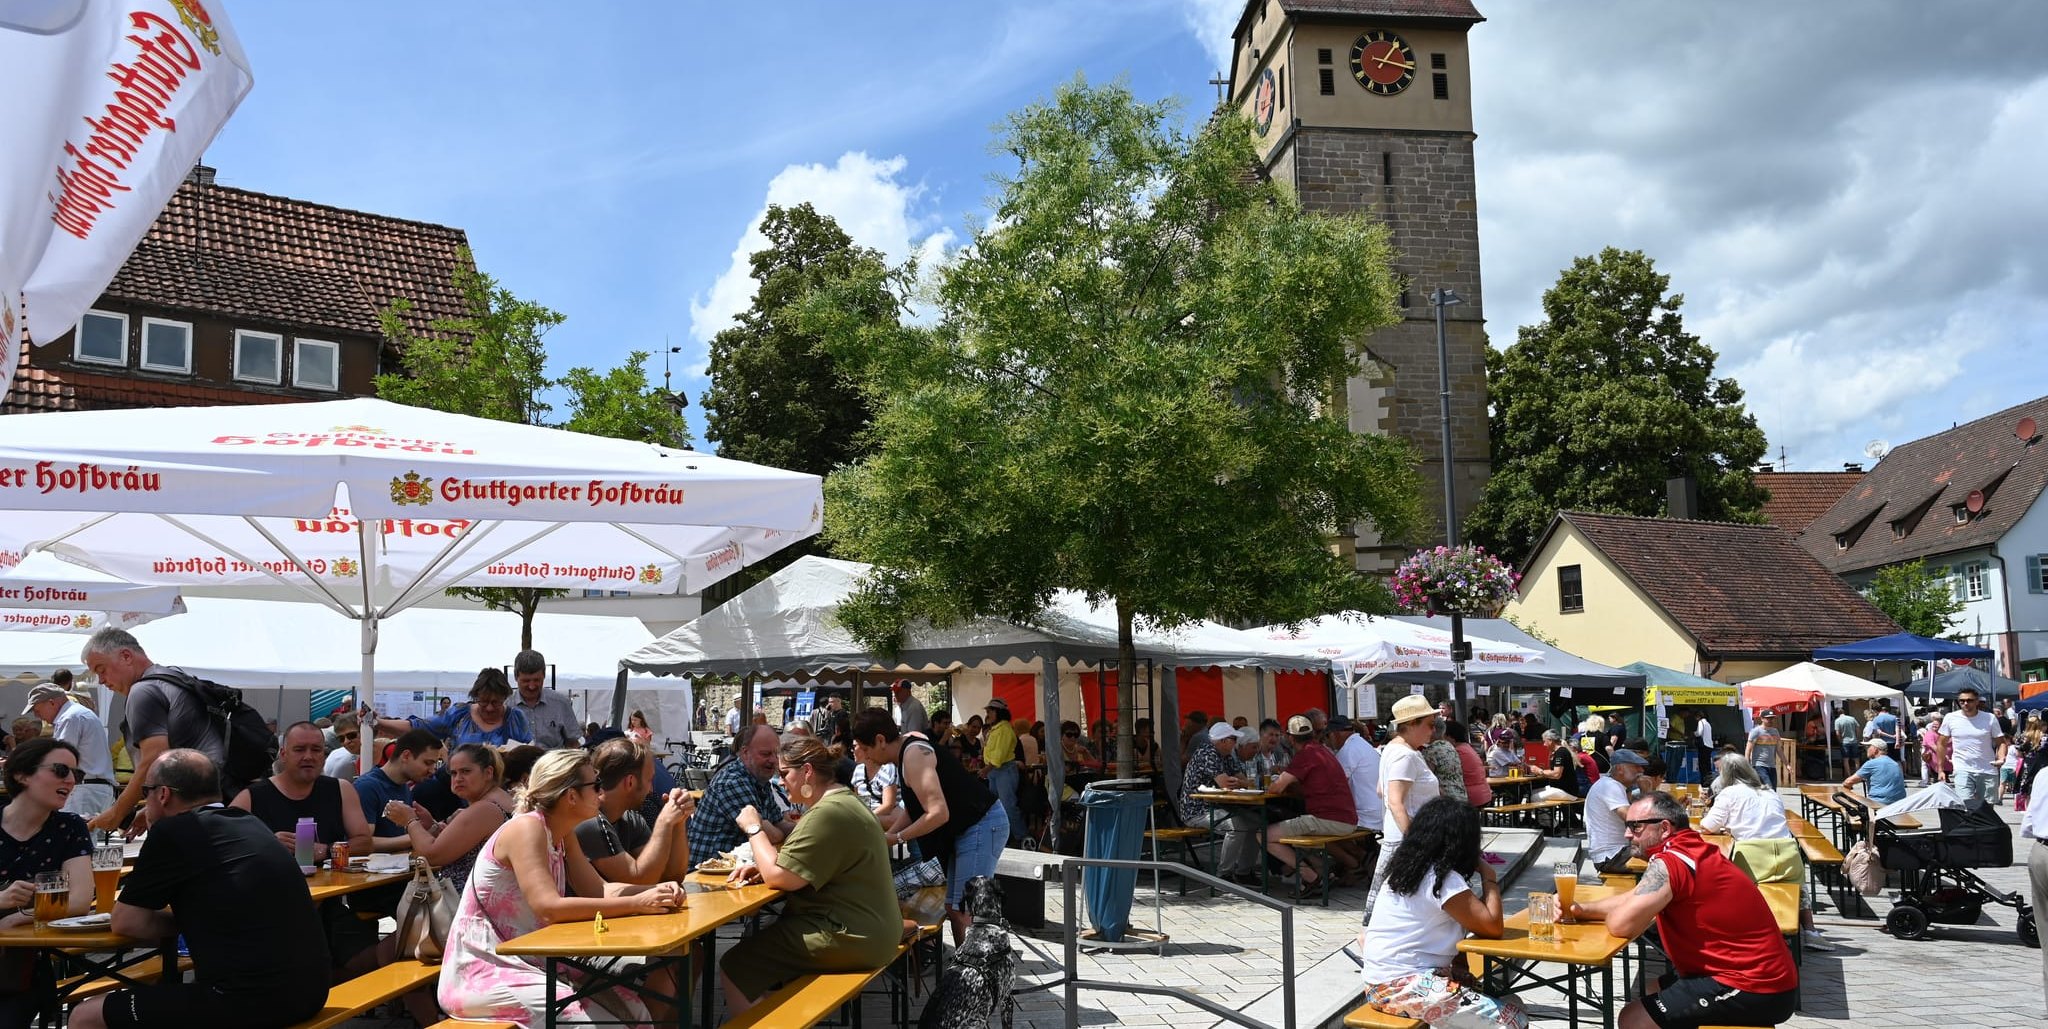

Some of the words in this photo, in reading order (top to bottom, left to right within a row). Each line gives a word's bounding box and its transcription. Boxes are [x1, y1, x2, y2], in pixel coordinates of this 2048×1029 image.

[36, 461, 161, 494] Hofbräu
[440, 477, 583, 507] Stuttgarter
[587, 480, 684, 507] Hofbräu
[24, 586, 88, 603] Hofbräu
